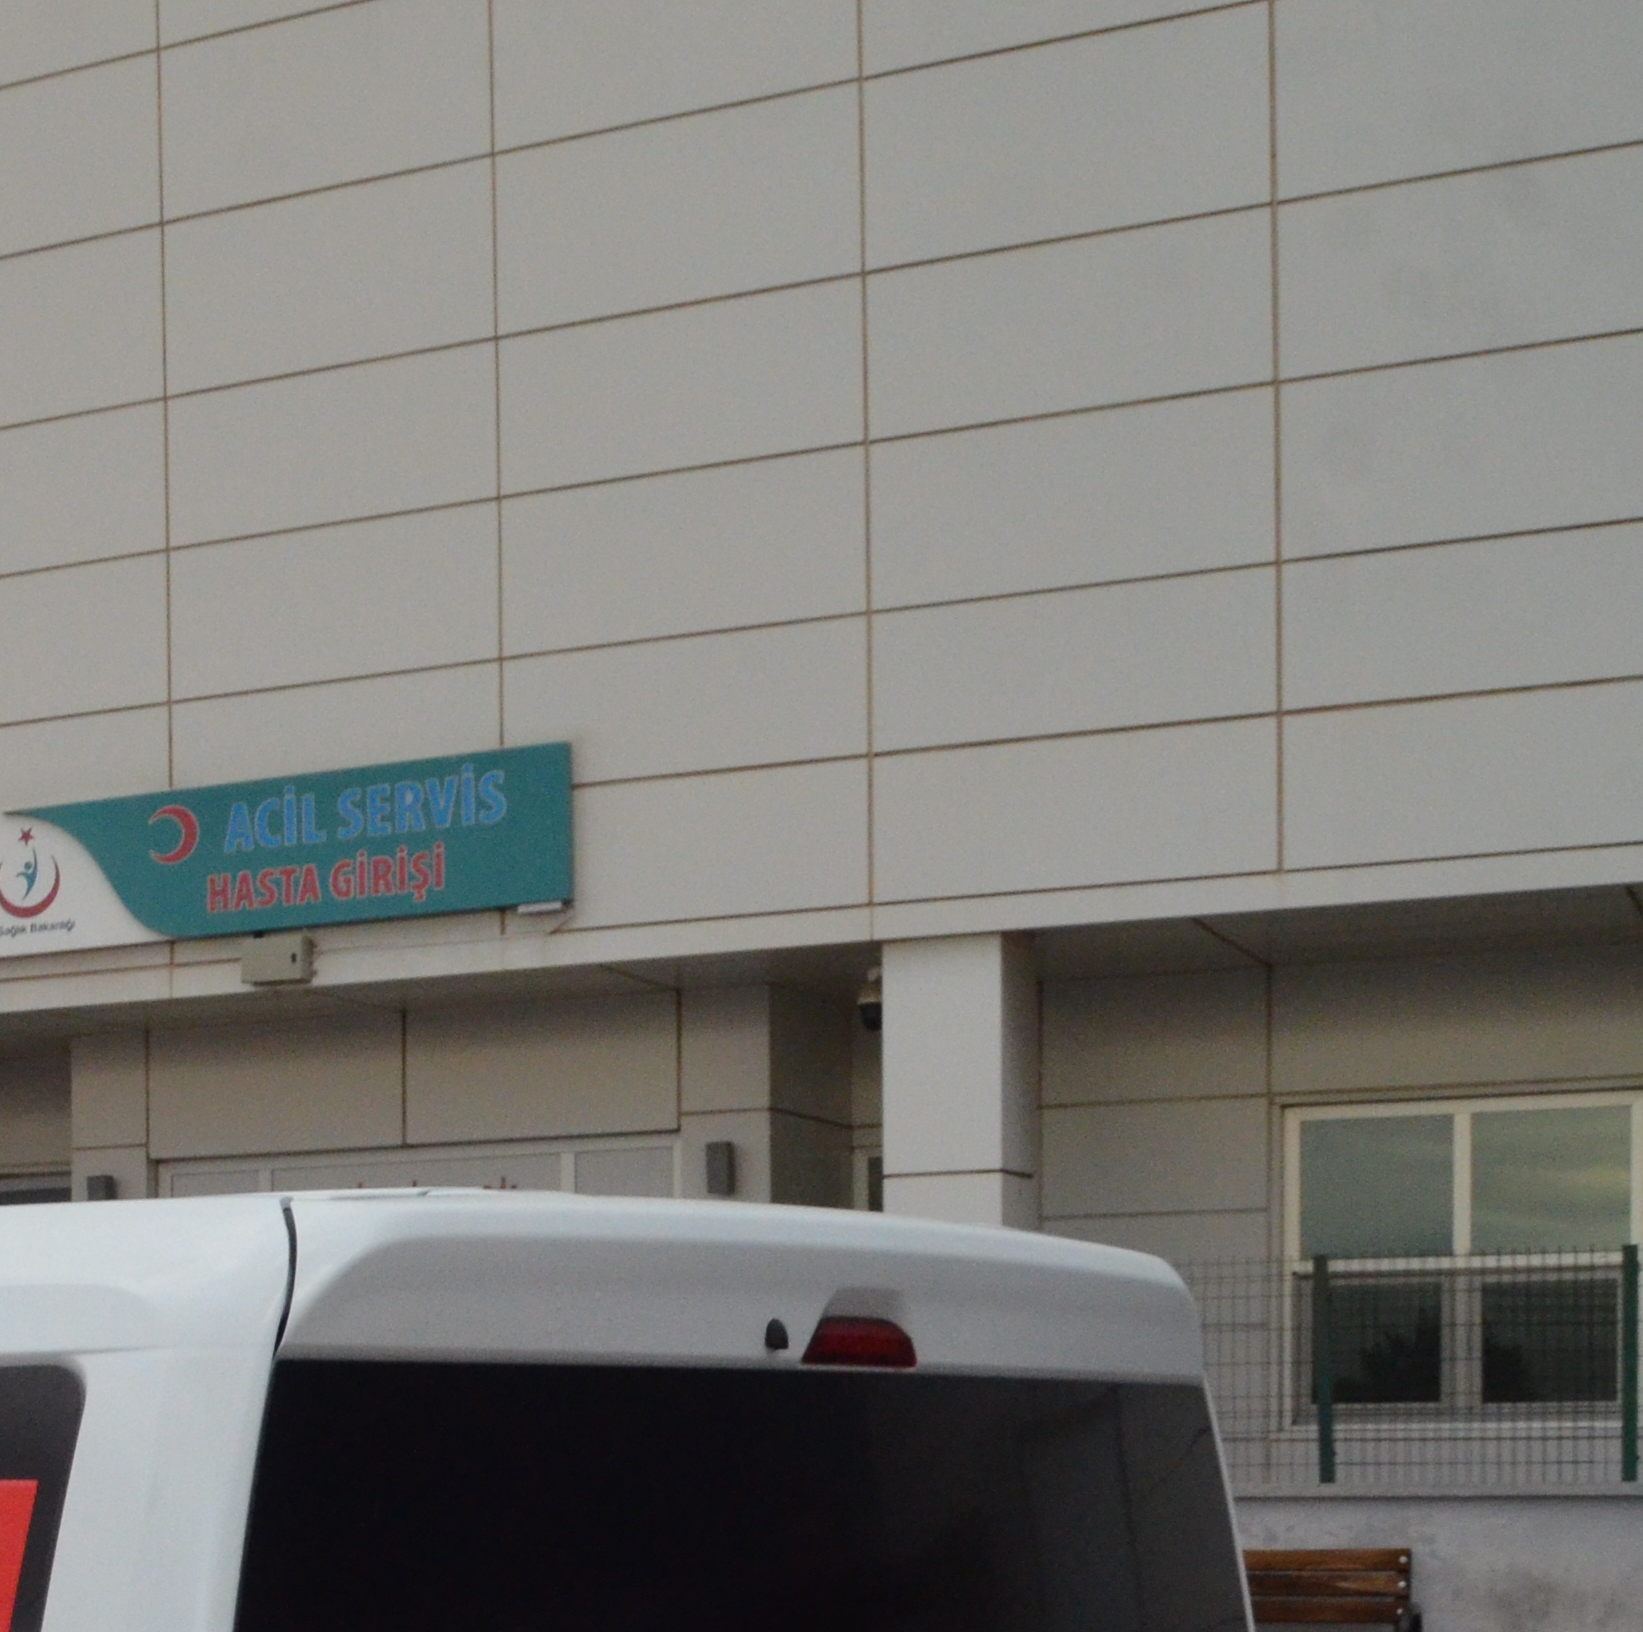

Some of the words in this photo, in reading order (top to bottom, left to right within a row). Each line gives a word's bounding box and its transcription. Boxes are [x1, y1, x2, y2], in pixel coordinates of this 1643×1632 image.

[222, 785, 326, 854] ACİL
[337, 763, 508, 842] SERVİS
[206, 860, 321, 912] HASTA
[329, 842, 446, 901] GİRİŞİ
